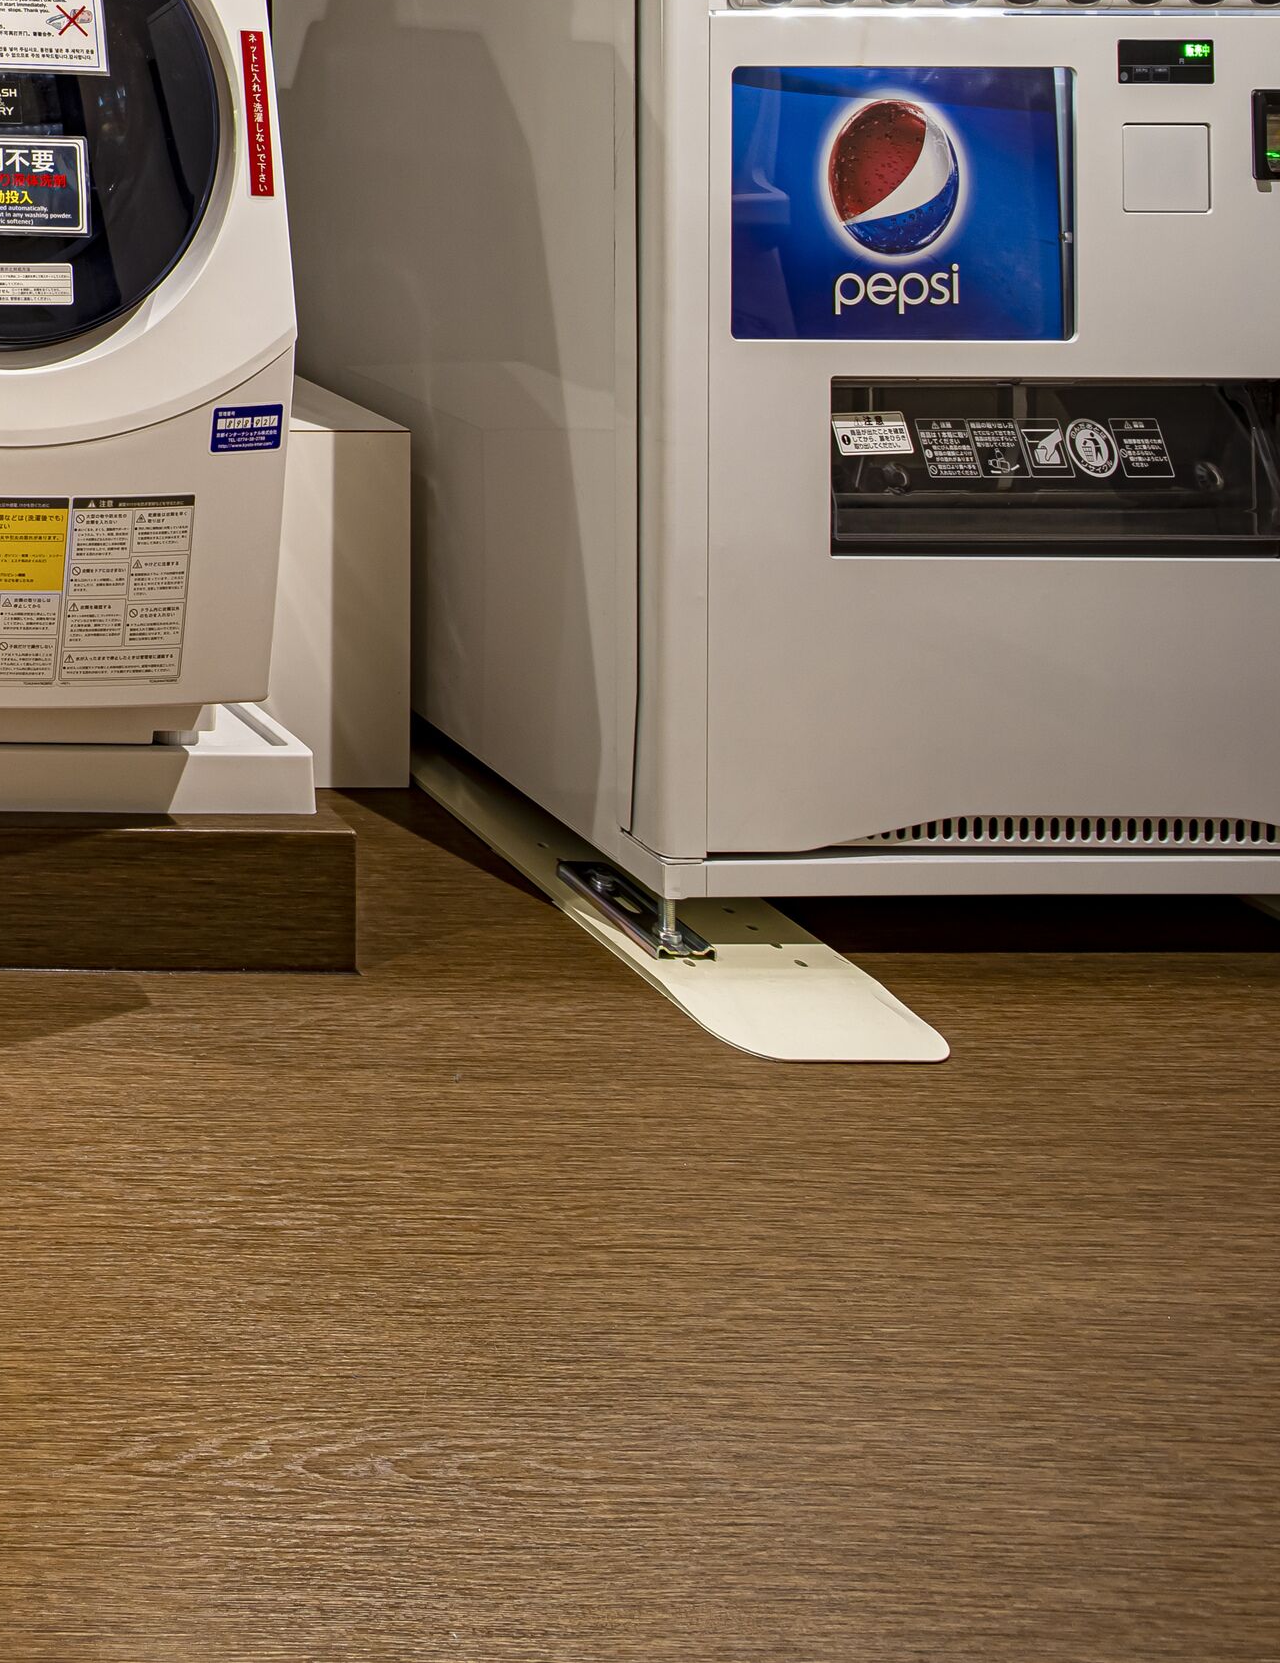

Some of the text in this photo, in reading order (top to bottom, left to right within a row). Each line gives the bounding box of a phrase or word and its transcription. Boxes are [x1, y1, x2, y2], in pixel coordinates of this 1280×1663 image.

[247, 33, 269, 193] ネットに入れて洗濯しないで下さい
[834, 263, 960, 315] pepsi
[862, 416, 884, 425] 注意
